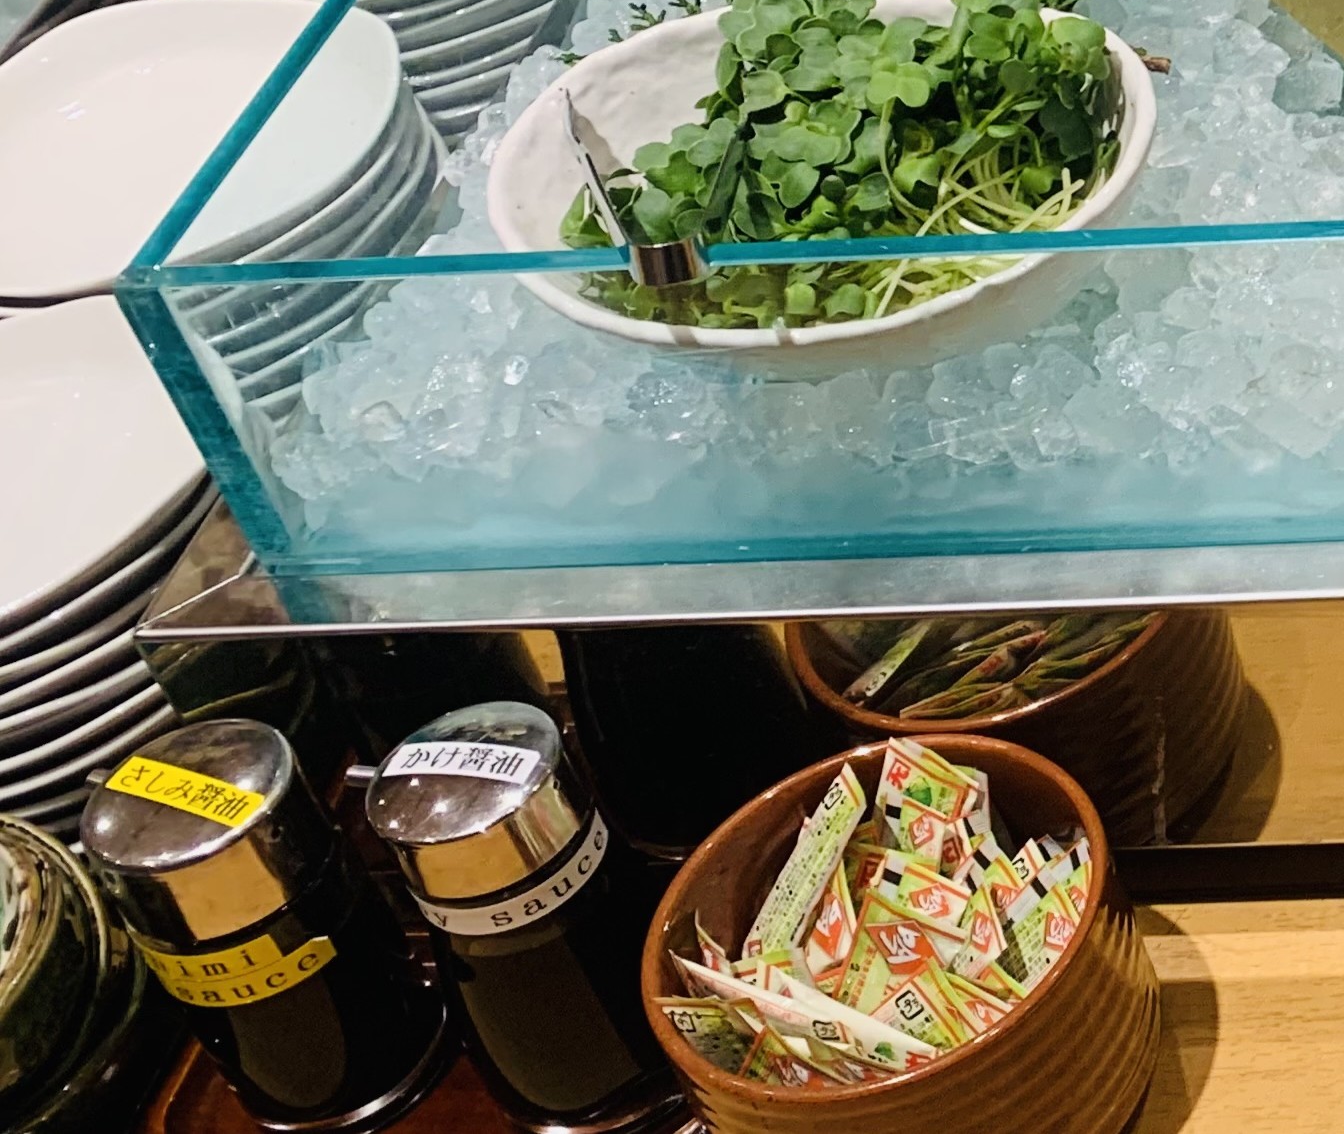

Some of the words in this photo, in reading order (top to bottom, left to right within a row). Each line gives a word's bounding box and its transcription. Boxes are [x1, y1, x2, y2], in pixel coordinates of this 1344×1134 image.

[400, 747, 524, 777] かけ醤油
[491, 831, 602, 927] sauce
[176, 953, 319, 1002] sauce
